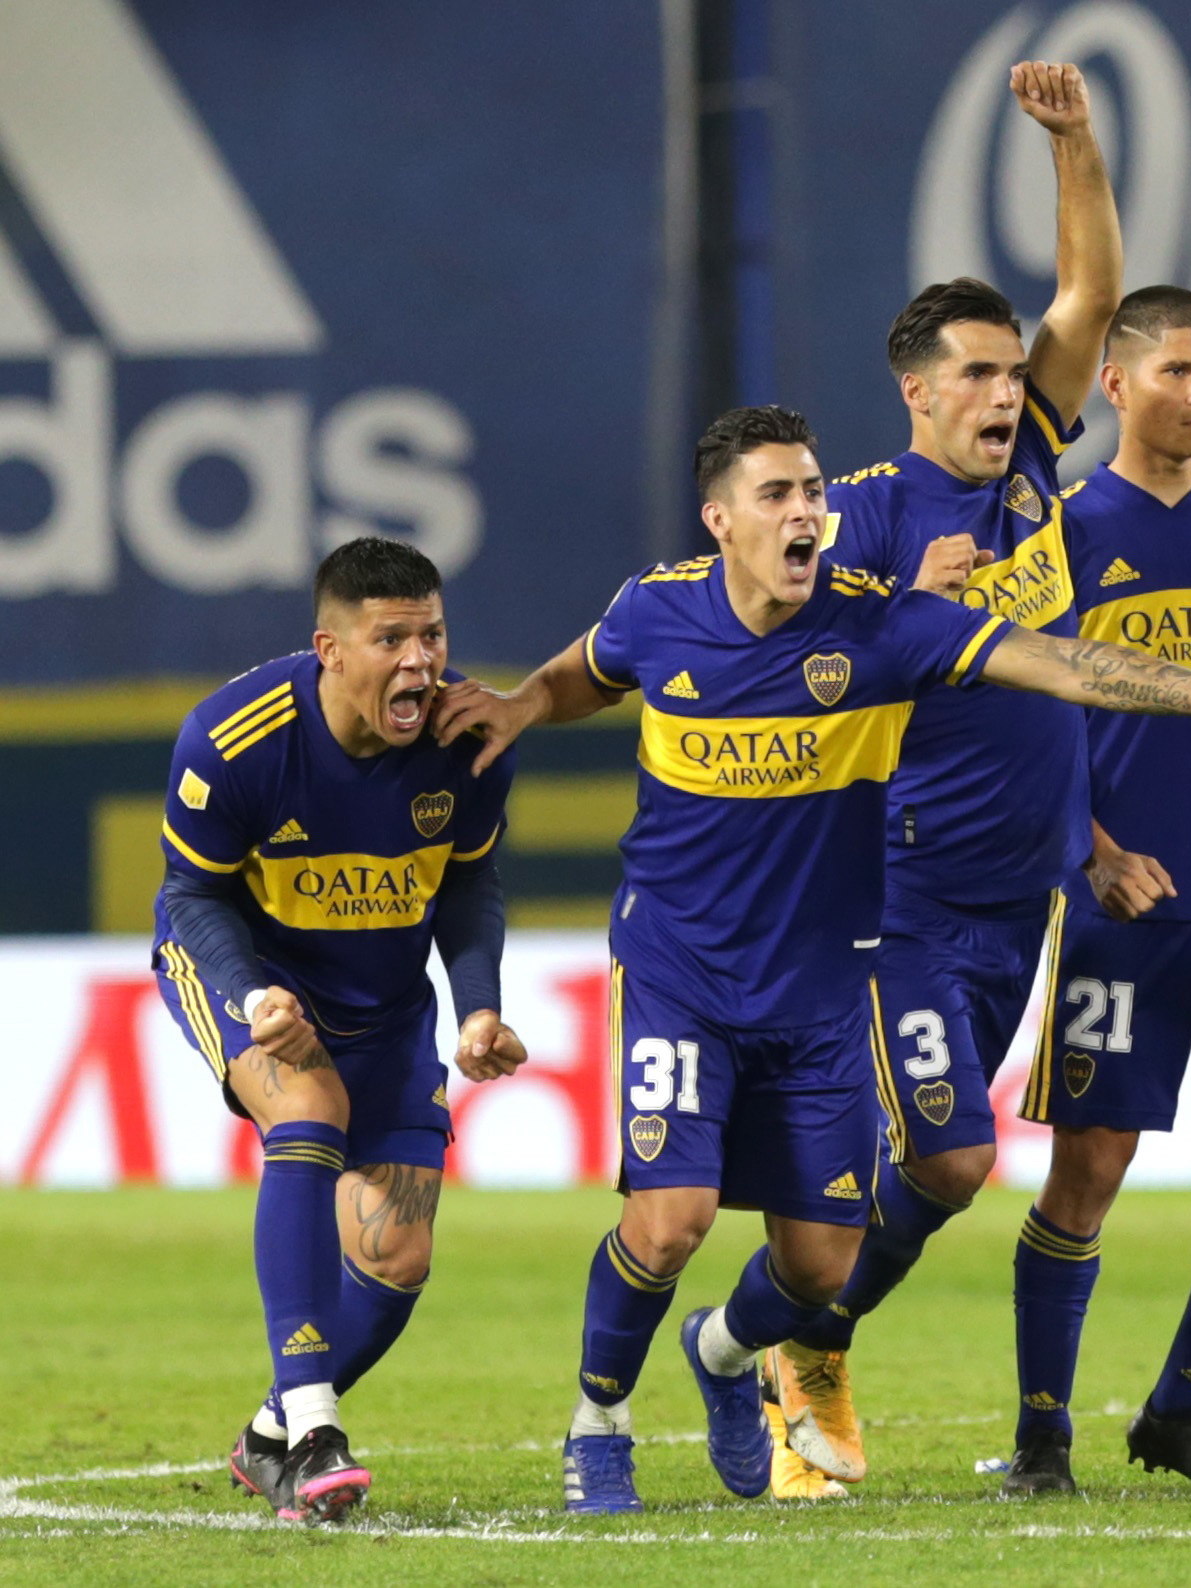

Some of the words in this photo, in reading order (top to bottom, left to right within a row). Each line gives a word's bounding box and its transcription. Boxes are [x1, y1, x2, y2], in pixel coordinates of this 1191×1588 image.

[1099, 569, 1141, 587] adidas
[810, 670, 845, 683] CABJ
[662, 685, 700, 700] adidas
[680, 730, 820, 770] QATAR
[715, 761, 821, 786] AIRWAYS
[416, 806, 448, 820] CABJ
[269, 831, 309, 845] adidas
[293, 862, 418, 904] QATAR
[1064, 975, 1135, 1054] 21
[897, 1009, 951, 1080] 3
[630, 1037, 700, 1114] 31
[635, 1131, 661, 1141] CABJ
[824, 1186, 862, 1200] adidas
